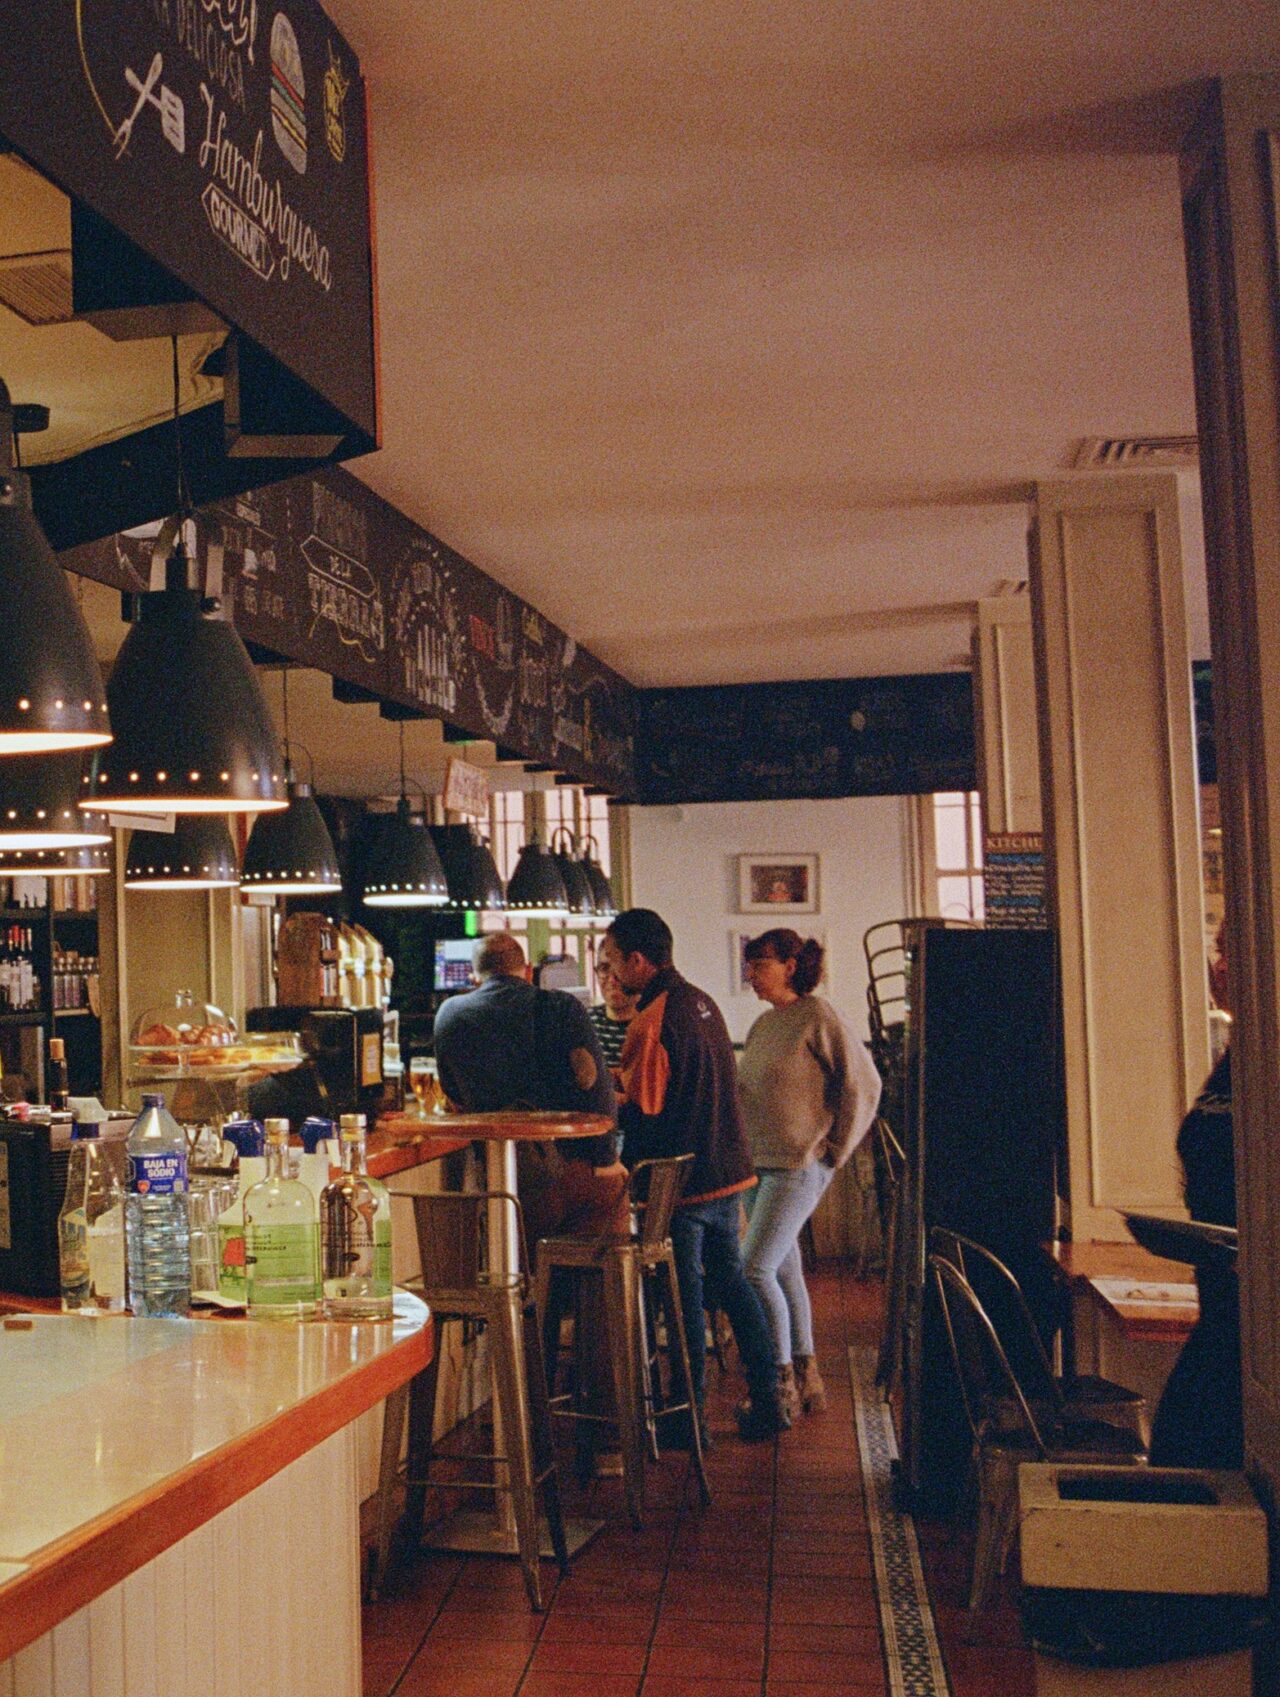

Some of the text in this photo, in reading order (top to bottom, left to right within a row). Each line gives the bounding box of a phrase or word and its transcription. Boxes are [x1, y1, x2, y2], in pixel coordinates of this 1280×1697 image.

[200, 82, 332, 291] Hamburguesa
[210, 190, 268, 270] GOURMET
[143, 1158, 179, 1169] BAJA EN
[147, 1168, 176, 1178] SODIO
